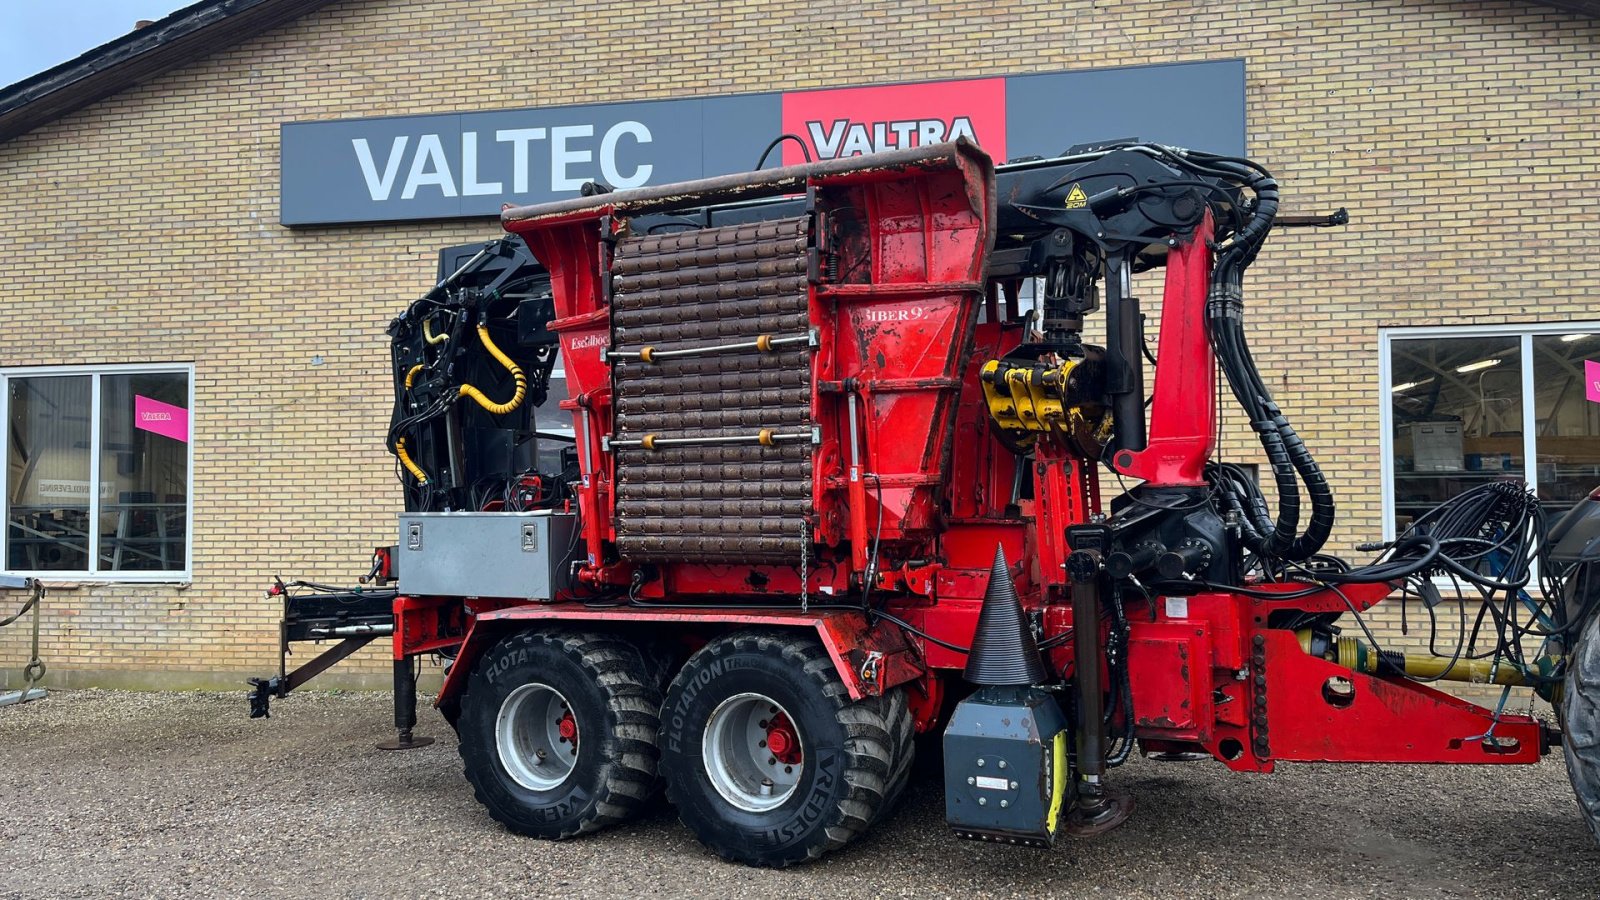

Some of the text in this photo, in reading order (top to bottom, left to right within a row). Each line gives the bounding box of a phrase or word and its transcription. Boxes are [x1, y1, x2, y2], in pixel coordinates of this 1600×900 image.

[352, 121, 653, 201] VALTEC
[805, 116, 980, 160] VALTRA
[669, 660, 722, 753] FLOTATION
